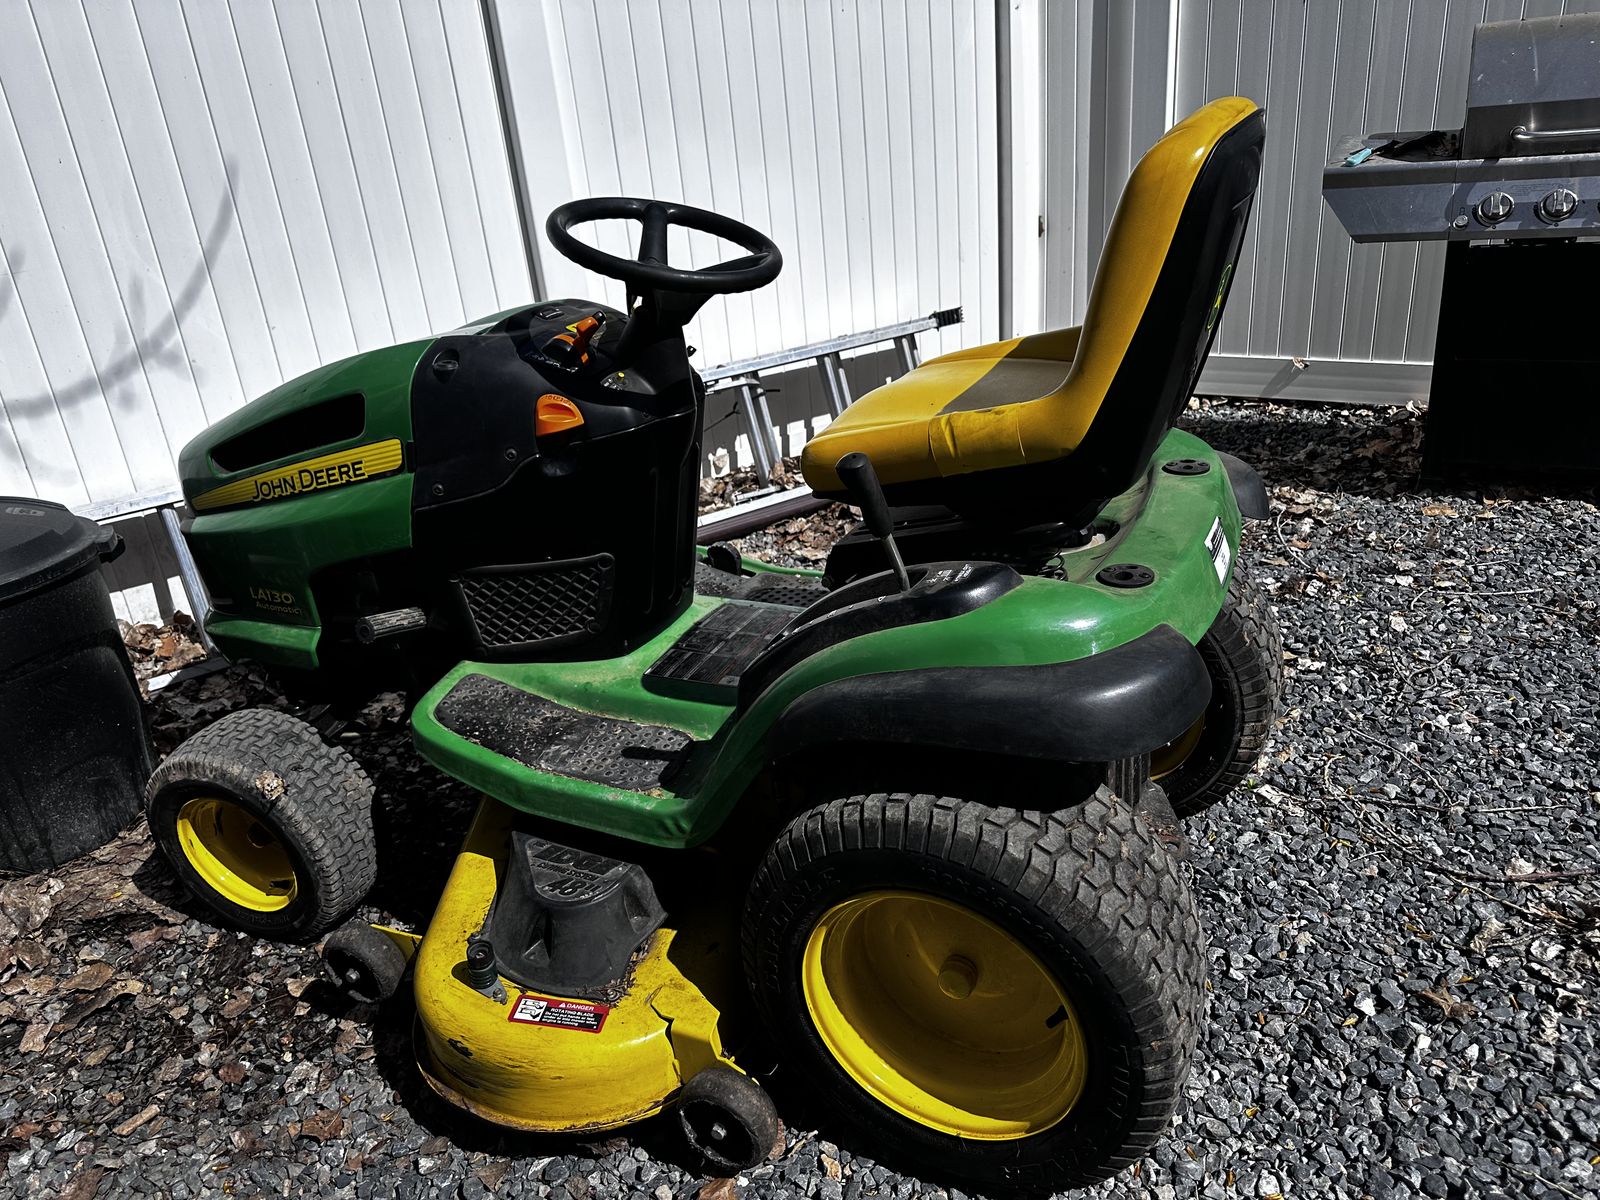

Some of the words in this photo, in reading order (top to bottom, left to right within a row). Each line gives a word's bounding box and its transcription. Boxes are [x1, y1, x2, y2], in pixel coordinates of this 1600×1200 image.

[252, 476, 297, 500] JOHN
[298, 460, 366, 490] DEERE
[249, 585, 293, 604] LA130
[255, 600, 302, 615] Automatic
[567, 1003, 594, 1011] DANGER
